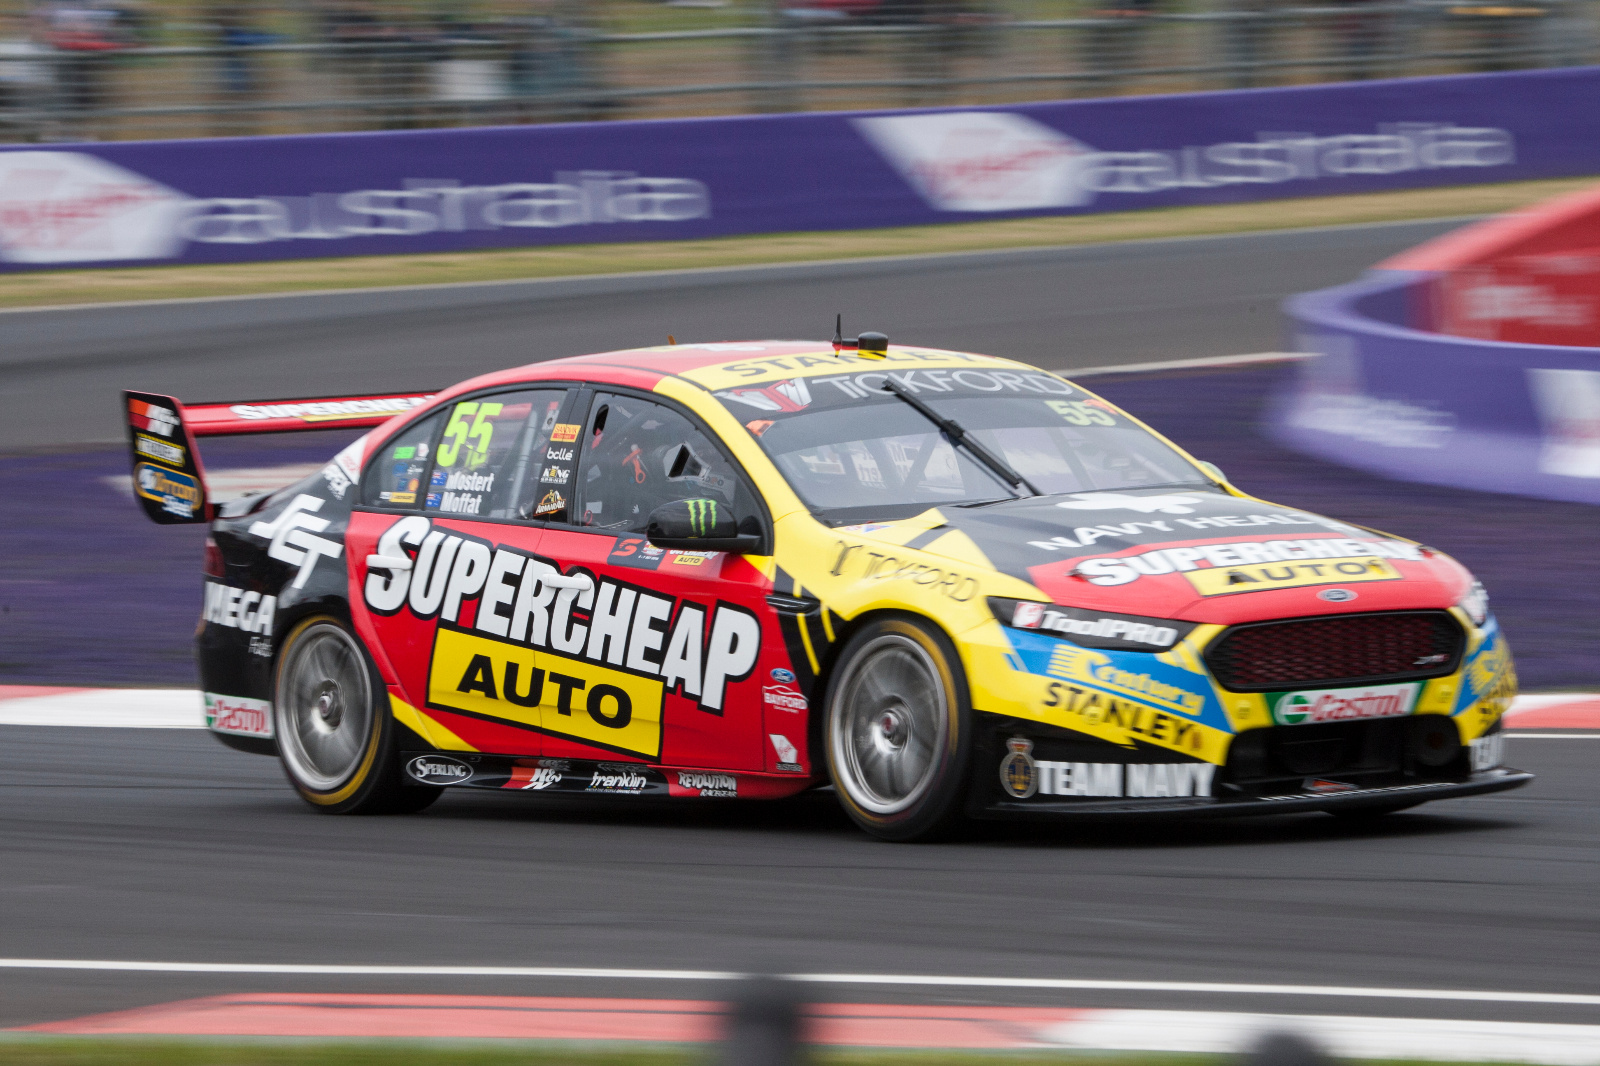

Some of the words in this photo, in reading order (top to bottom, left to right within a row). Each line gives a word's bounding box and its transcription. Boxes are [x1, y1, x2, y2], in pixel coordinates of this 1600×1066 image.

[812, 367, 1074, 399] TICKFORD
[1043, 400, 1117, 426] 55
[436, 402, 504, 471] 55
[445, 471, 494, 492] Mostert
[440, 492, 482, 514] Moffat
[1026, 520, 1174, 550] NAVY
[678, 556, 701, 564] AUTO
[1228, 562, 1367, 585] AUTO
[364, 515, 761, 710] SUPERCHEAP
[455, 653, 633, 729] AUTO
[1047, 644, 1205, 716] Century
[1043, 682, 1196, 746] STANLEY
[590, 771, 647, 788] franklin
[678, 771, 737, 791] REVOLUTION
[1034, 760, 1123, 797] TEAM
[1126, 762, 1216, 797] NAVY
